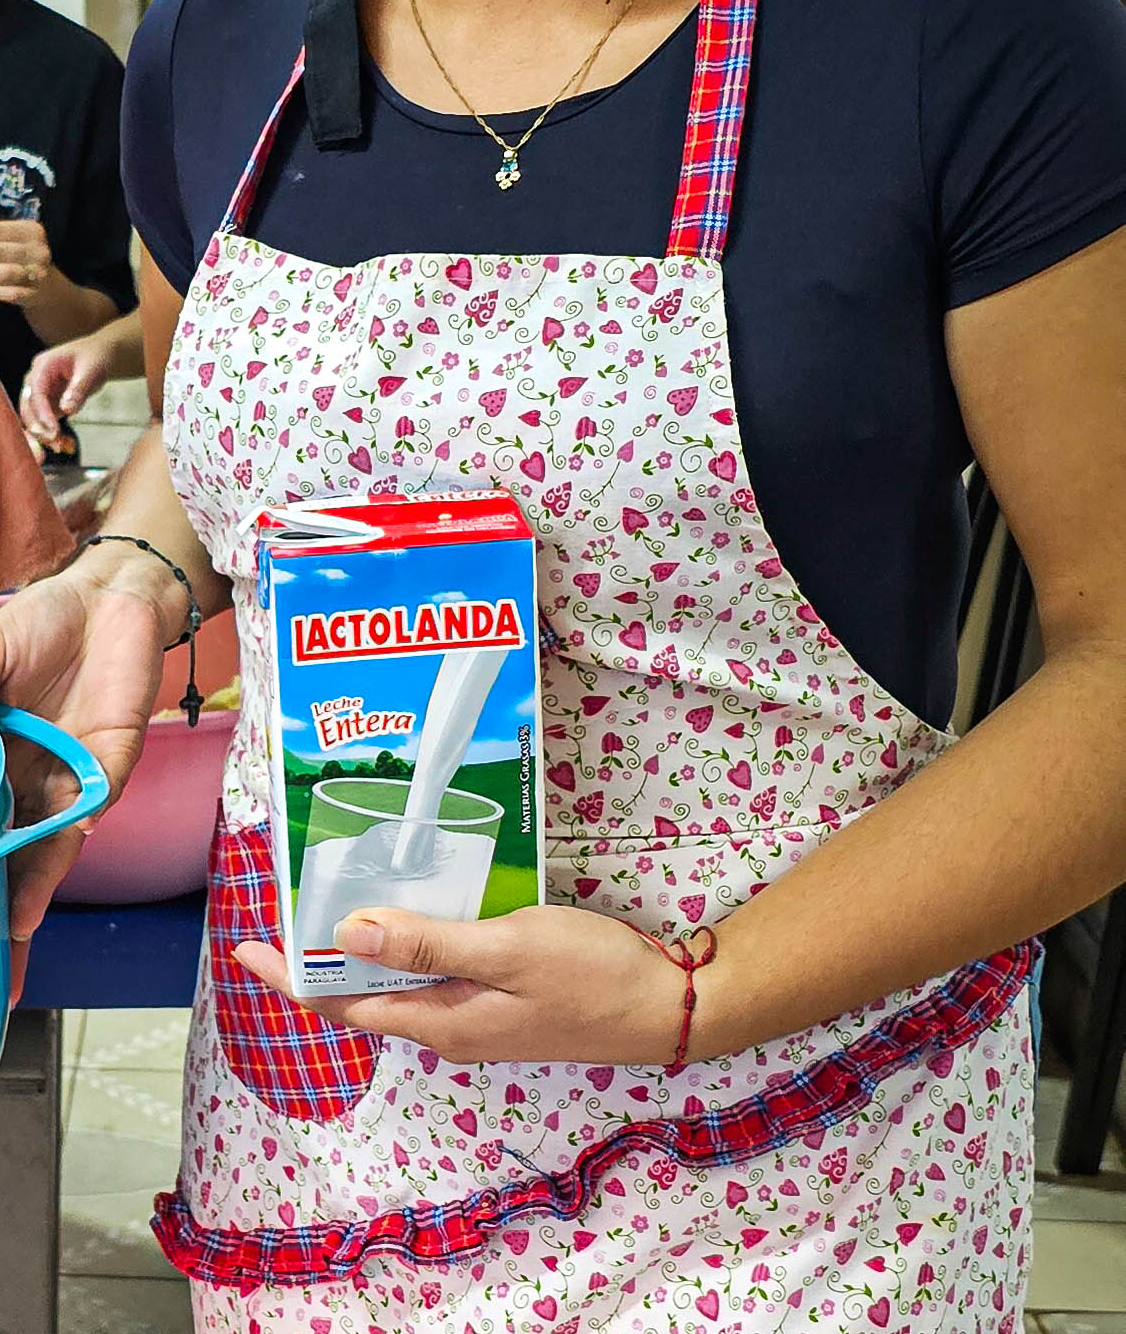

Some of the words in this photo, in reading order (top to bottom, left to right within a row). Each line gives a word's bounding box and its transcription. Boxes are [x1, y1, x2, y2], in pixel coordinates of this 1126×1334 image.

[294, 602, 520, 662] LACTOLANDA
[313, 697, 362, 717] Leche
[319, 712, 413, 748] Entera
